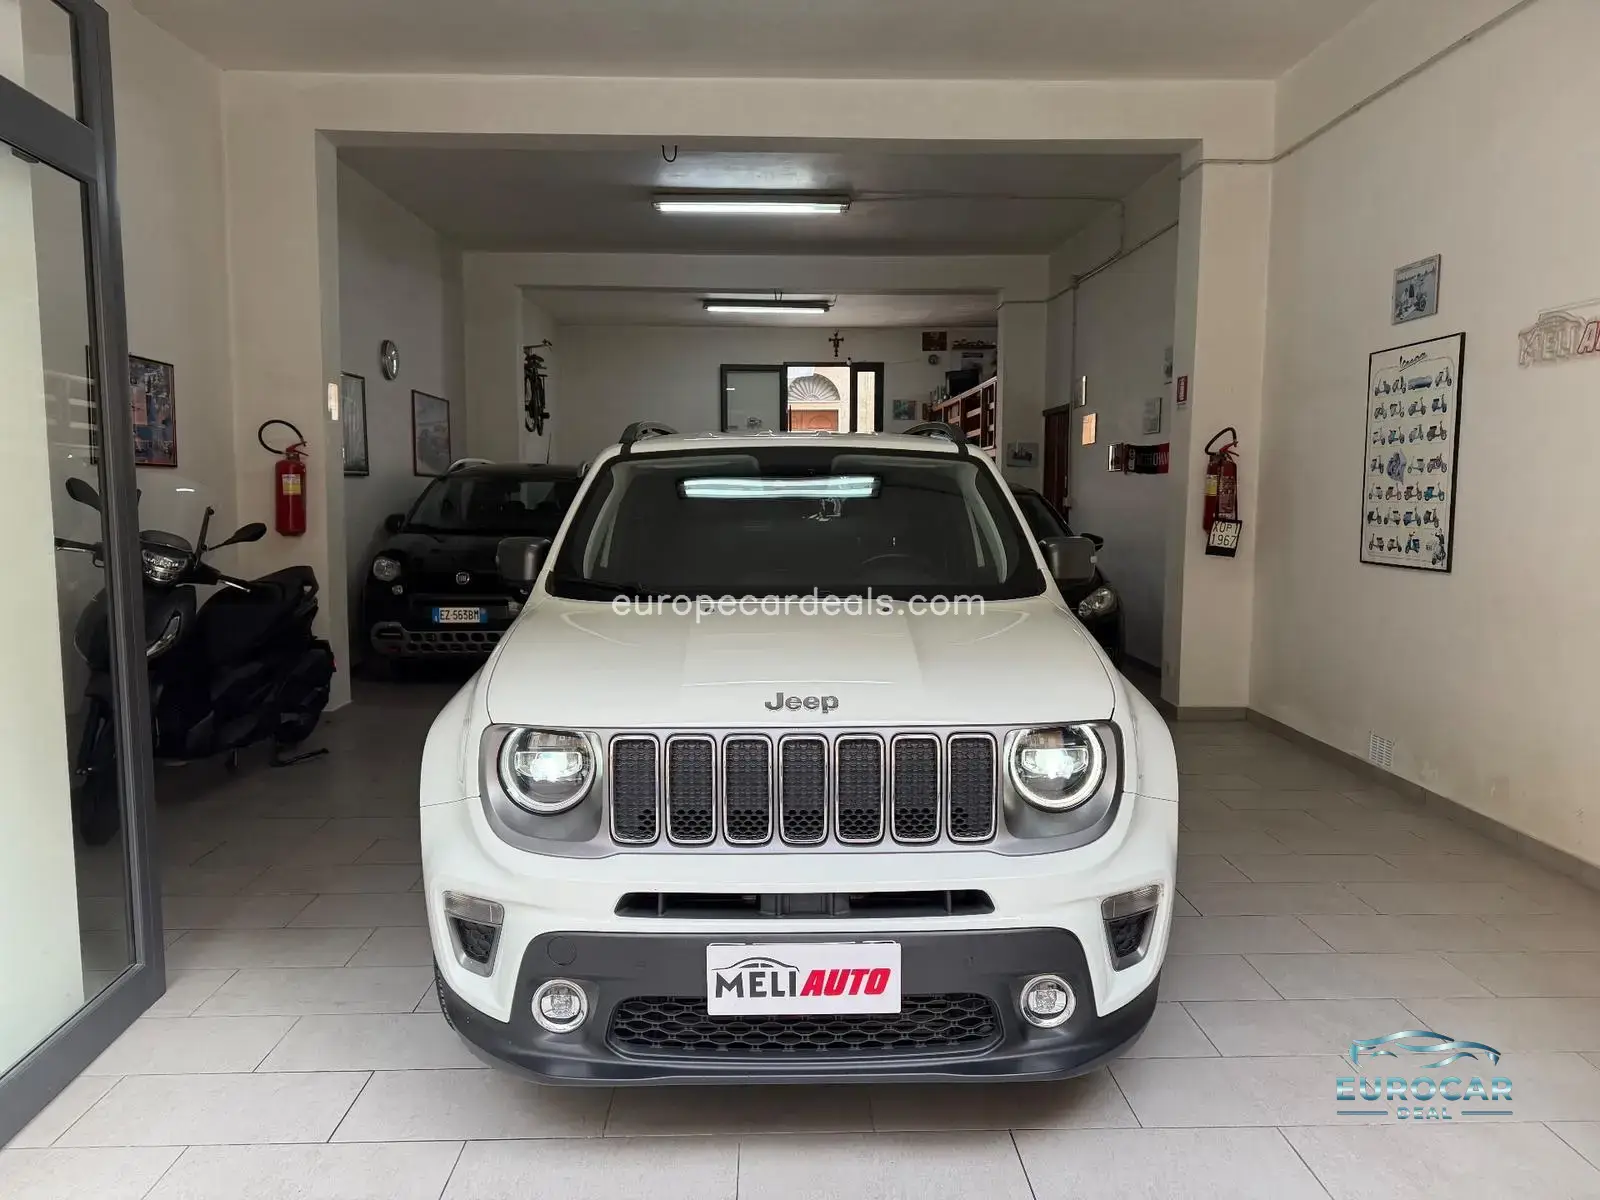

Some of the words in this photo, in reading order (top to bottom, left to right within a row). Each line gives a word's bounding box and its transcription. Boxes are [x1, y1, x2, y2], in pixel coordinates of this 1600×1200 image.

[1212, 534, 1237, 546] 1967
[765, 692, 839, 714] Jeep
[715, 971, 797, 998] MELI
[800, 968, 891, 997] AUTO
